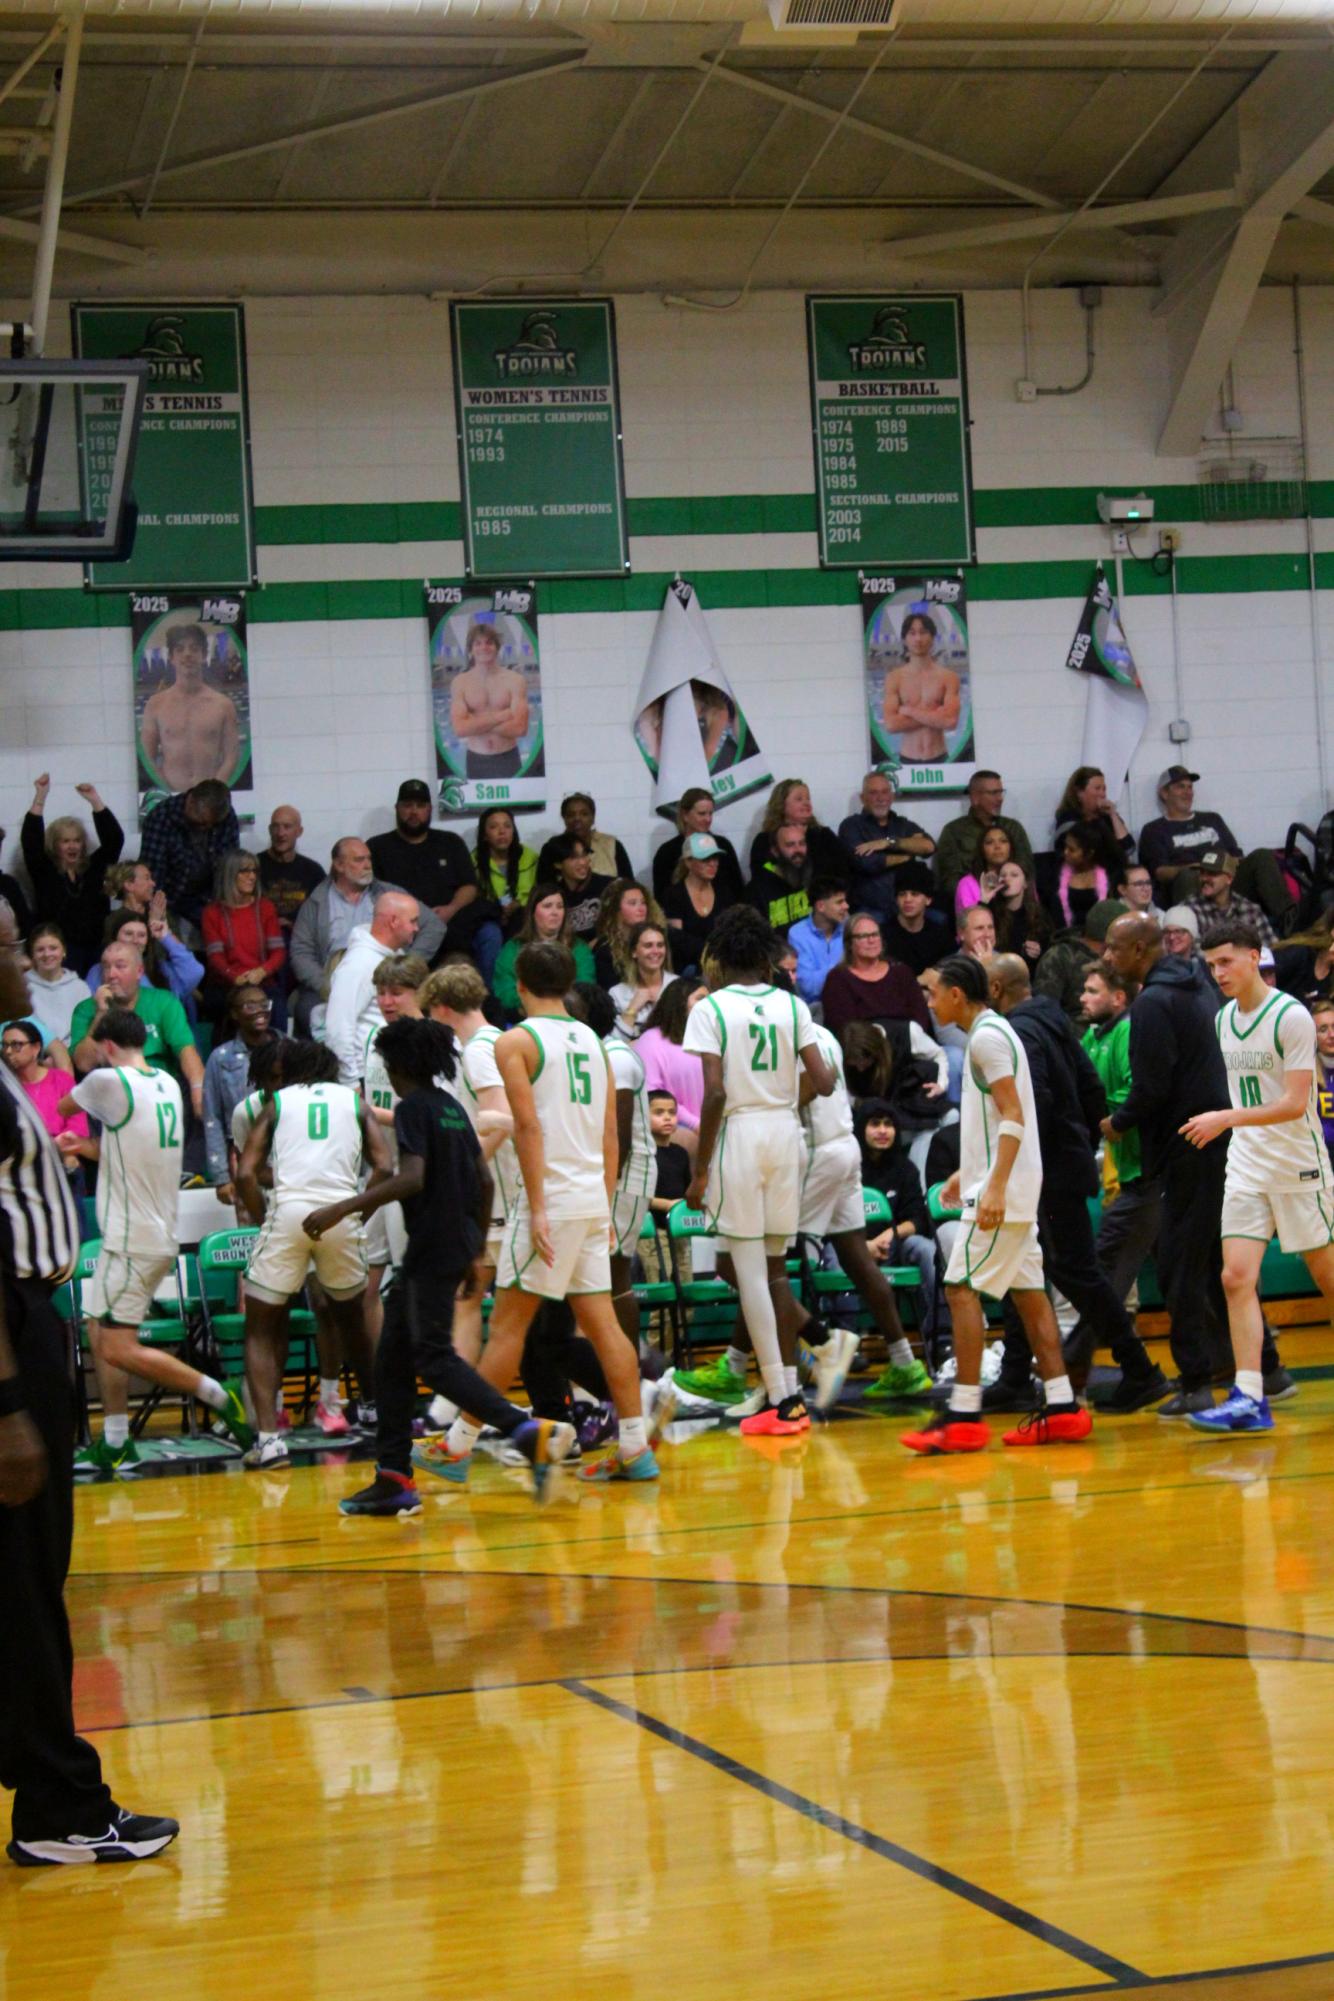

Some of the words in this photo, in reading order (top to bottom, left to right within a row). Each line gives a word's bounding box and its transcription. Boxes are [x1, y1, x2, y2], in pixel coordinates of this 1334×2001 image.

[496, 353, 577, 378] TROJANS
[849, 346, 927, 371] TROJANS
[148, 358, 203, 383] OJANS
[468, 390, 543, 404] WOMEN'S
[548, 389, 608, 403] TENNIS
[838, 382, 939, 396] BASKETBALL
[160, 396, 222, 410] TENNIS
[823, 405, 892, 416] CONFERENCE
[896, 404, 957, 415] CHAMPIONS
[170, 419, 237, 430] CHAMPIONS
[468, 413, 540, 424] CONFERENCE
[544, 411, 609, 423] CHAMPIONS
[822, 421, 853, 435] 1974
[875, 419, 907, 433] 1989
[468, 429, 503, 443] 1974
[824, 438, 854, 452] 1975
[877, 437, 908, 452] 2015
[469, 447, 504, 462] 1993
[824, 456, 856, 470] 1984
[825, 474, 857, 488] 1985
[830, 494, 891, 506] SECTIONAL
[895, 492, 959, 504] CHAMPIONS
[476, 505, 537, 517] REGIONAL
[541, 503, 613, 515] CHAMPIONS
[827, 510, 861, 525] 2003
[166, 513, 239, 525] CHAMPIONS
[474, 520, 511, 535] 1985
[829, 528, 861, 543] 2014
[676, 580, 691, 600] 20
[863, 578, 895, 593] 2025
[428, 588, 462, 603] 2025
[494, 590, 531, 613] WB
[133, 597, 169, 612] 2025
[202, 600, 240, 623] WB
[1069, 633, 1092, 668] 2025
[911, 768, 944, 784] John
[475, 782, 510, 800] Sam
[749, 1024, 777, 1071] 21
[566, 1053, 591, 1104] 15
[156, 1103, 179, 1148] 12
[307, 1103, 329, 1140] 0
